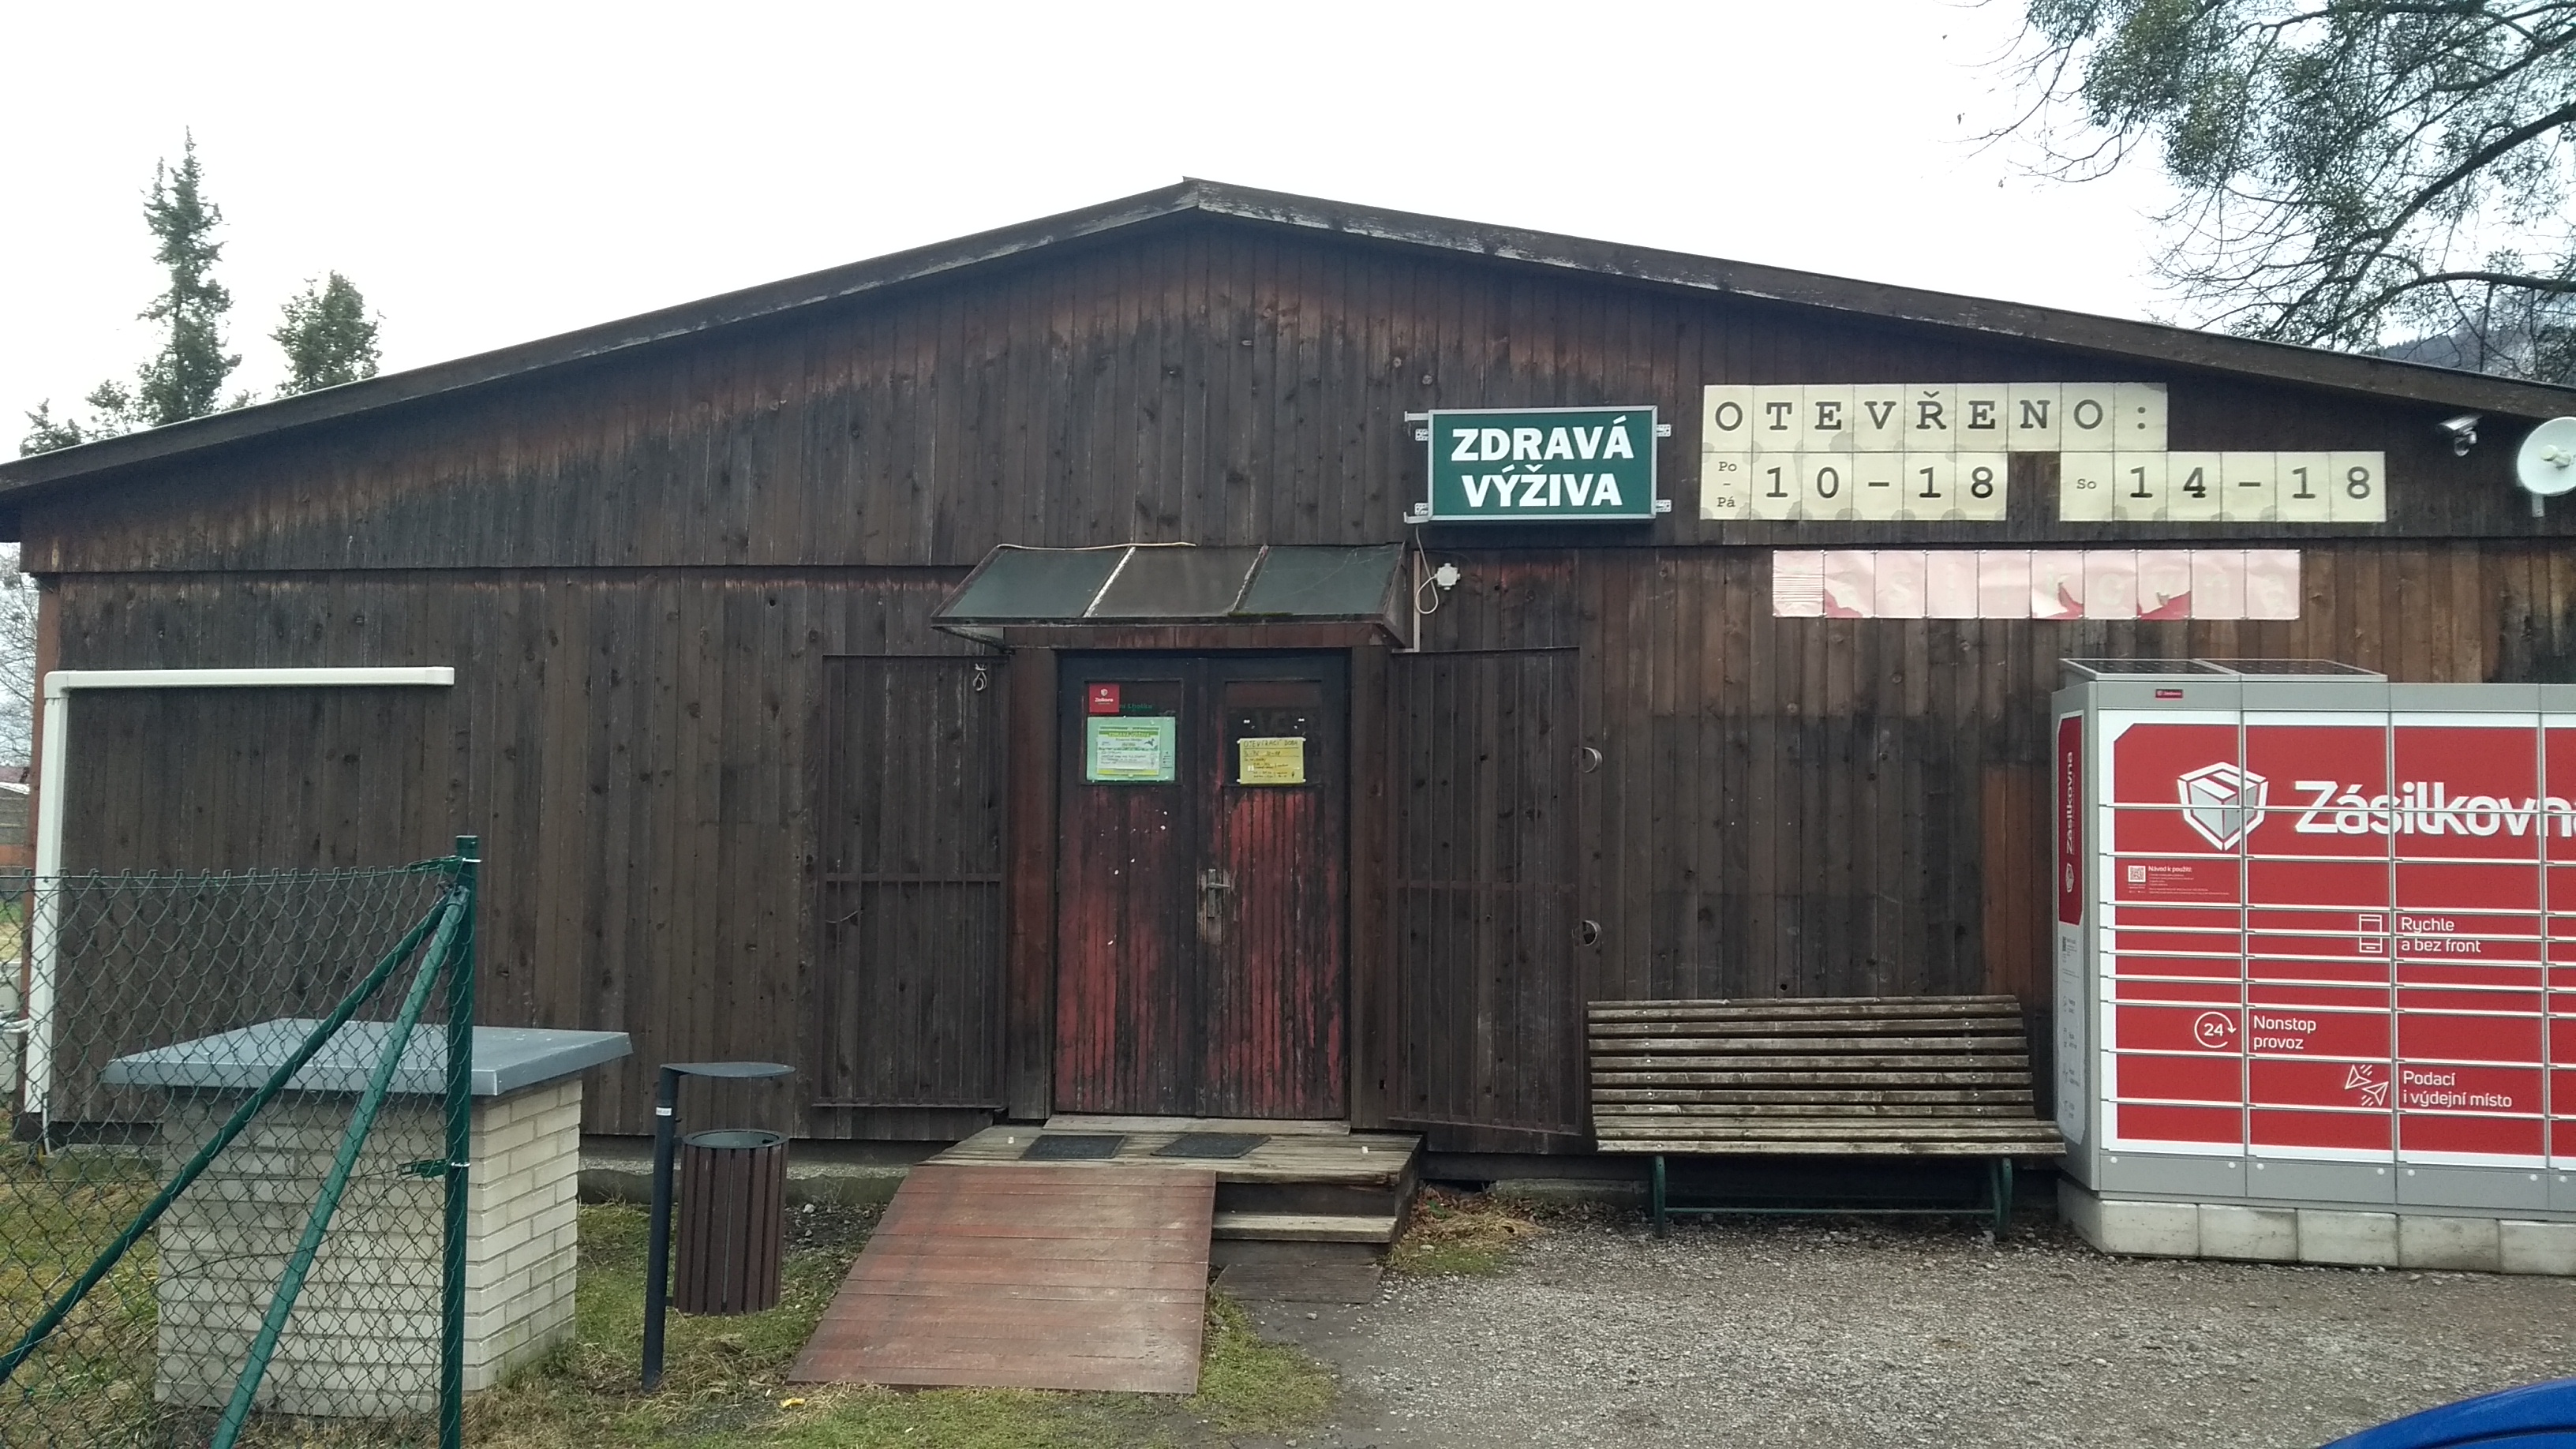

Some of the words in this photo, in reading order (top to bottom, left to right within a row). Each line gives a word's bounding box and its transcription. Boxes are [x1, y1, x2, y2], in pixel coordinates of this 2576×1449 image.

[1715, 391, 2147, 432] OTEVŘENO:
[1451, 415, 1634, 461] ZDRAVÁ
[1718, 462, 1738, 472] Po
[1461, 464, 1623, 507] VÝŽIVA
[1766, 466, 1994, 499] 10-18
[2076, 478, 2097, 490] So
[2130, 466, 2371, 499] 14-18
[1717, 496, 1735, 507] Pá
[2295, 781, 2576, 837] Zásilkovn
[2401, 916, 2455, 934] Rychle
[2401, 940, 2410, 951] a
[2414, 938, 2442, 952] bez
[2446, 938, 2481, 953] front
[2203, 1023, 2224, 1037] 24
[2253, 1015, 2316, 1034] Nonstop
[2253, 1036, 2304, 1050] provoz
[2403, 1070, 2456, 1086] Podací
[2403, 1089, 2407, 1103] i
[2410, 1090, 2467, 1108] výdejní
[2470, 1093, 2512, 1107] místo
